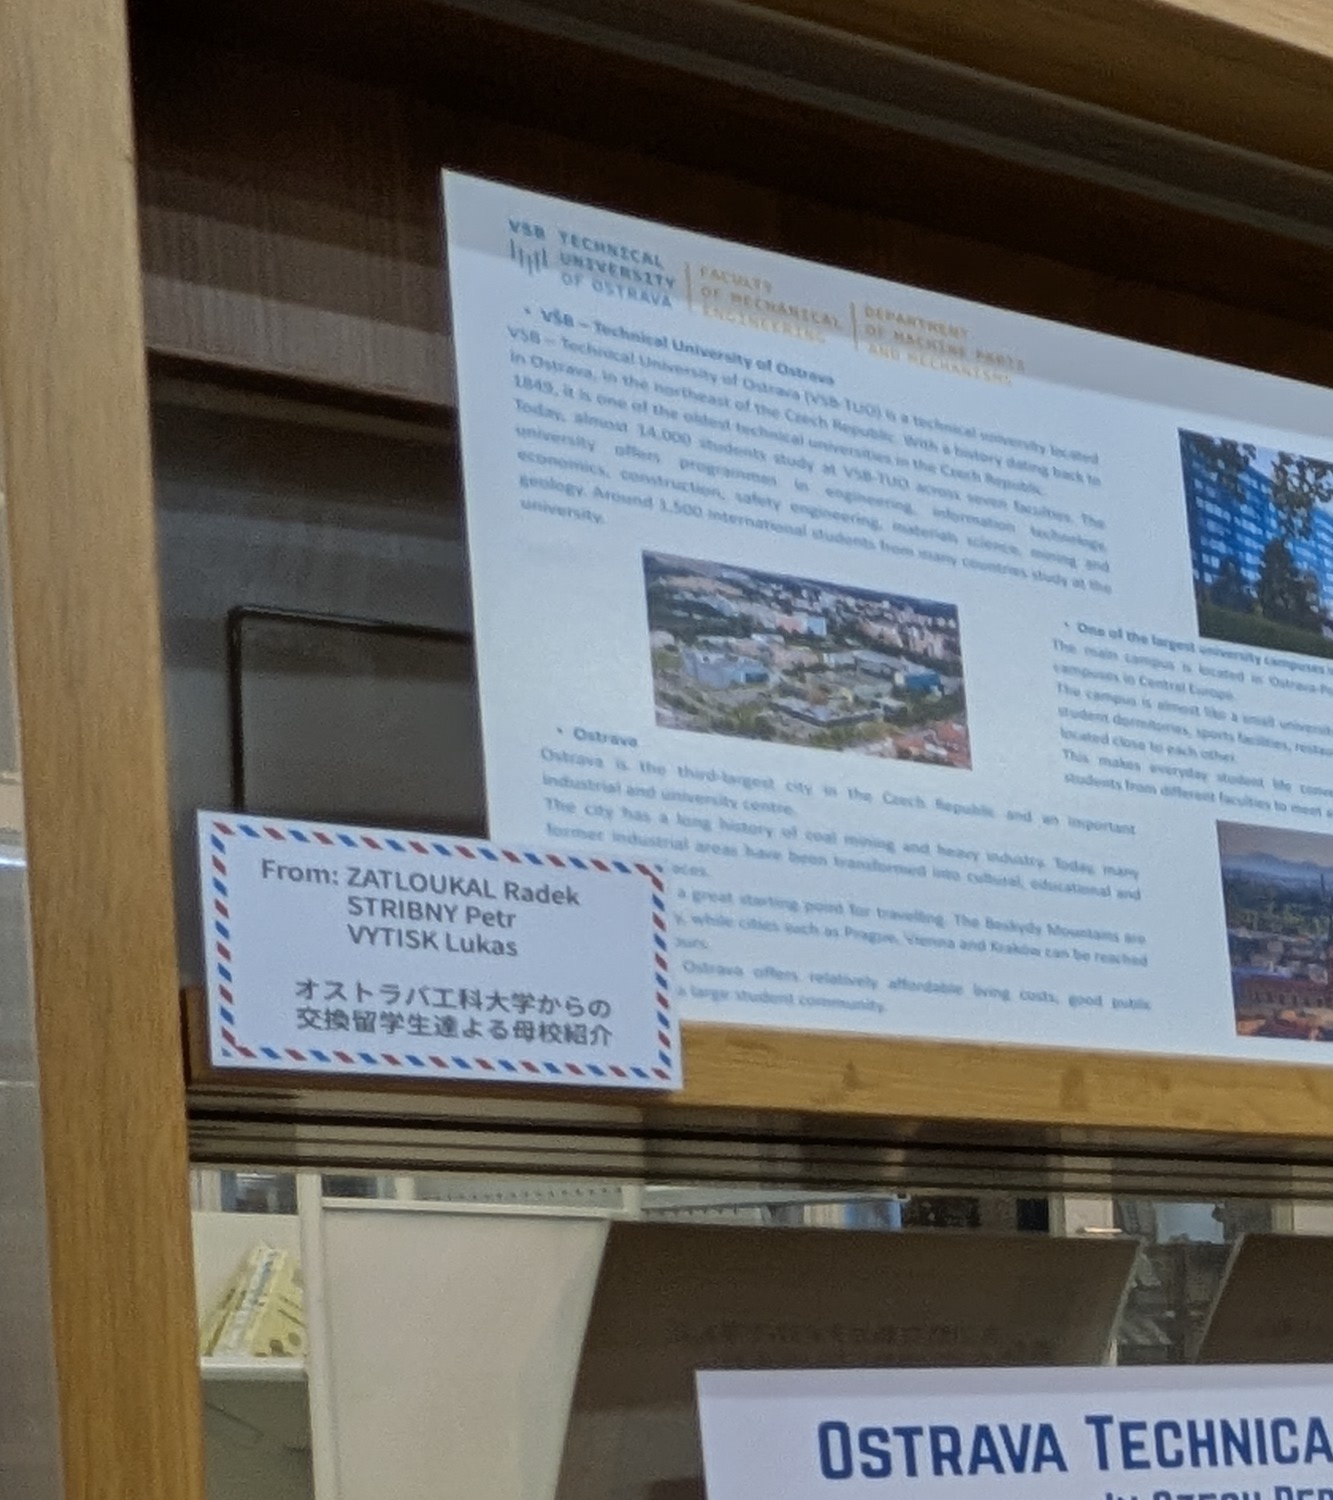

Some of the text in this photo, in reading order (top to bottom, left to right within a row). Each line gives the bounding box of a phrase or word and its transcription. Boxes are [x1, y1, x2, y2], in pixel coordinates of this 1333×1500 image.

[507, 218, 665, 270] VSB TECHNICAL
[558, 250, 676, 292] UNIVERSITY
[560, 270, 673, 310] OF OSTRAVA
[698, 264, 774, 296] FACULTY
[699, 284, 843, 331] OF MECHANICAL
[863, 303, 970, 341] DEPARTMENT
[590, 319, 671, 351] Technical
[670, 337, 756, 373] University
[752, 355, 775, 374] of
[773, 360, 837, 387] Ostrava
[865, 322, 885, 340] OF
[508, 348, 528, 367] in
[599, 367, 620, 386] in
[620, 372, 651, 392] the
[652, 379, 733, 410] northeast
[732, 396, 754, 414] of
[751, 400, 782, 420] the
[783, 406, 831, 430] Czech
[902, 432, 941, 453] With
[951, 442, 1004, 470] history
[1004, 454, 1052, 480] dating
[1050, 463, 1086, 484] back
[1085, 471, 1103, 488] to
[558, 336, 638, 367] Technical
[637, 353, 720, 388] University
[720, 371, 740, 389] of
[740, 375, 803, 402] Ostrava
[882, 406, 899, 423] is
[910, 412, 979, 440] technical
[978, 427, 1049, 459] university
[1047, 442, 1101, 466] located
[558, 382, 577, 400] it
[574, 385, 594, 404] is
[595, 394, 630, 411] one
[629, 397, 651, 416] of
[650, 401, 680, 421] the
[681, 408, 734, 432] oldest
[732, 418, 806, 447] technical
[806, 434, 894, 465] universities
[893, 451, 911, 469] in
[910, 455, 938, 474] the
[938, 461, 984, 483] Czech
[1074, 619, 1108, 638] One
[1106, 625, 1126, 641] of
[1123, 627, 1150, 645] the
[1149, 632, 1197, 657] largest
[1197, 640, 1263, 668] university
[1262, 655, 1327, 678] campuses
[571, 724, 639, 748] Ostrava
[259, 857, 581, 908] From: ZATLOUKAL Radek
[345, 893, 518, 930] STRIBNY Petr
[346, 923, 519, 958] VYTISK Lukas
[293, 975, 612, 1020] オストラバ工科大学からの
